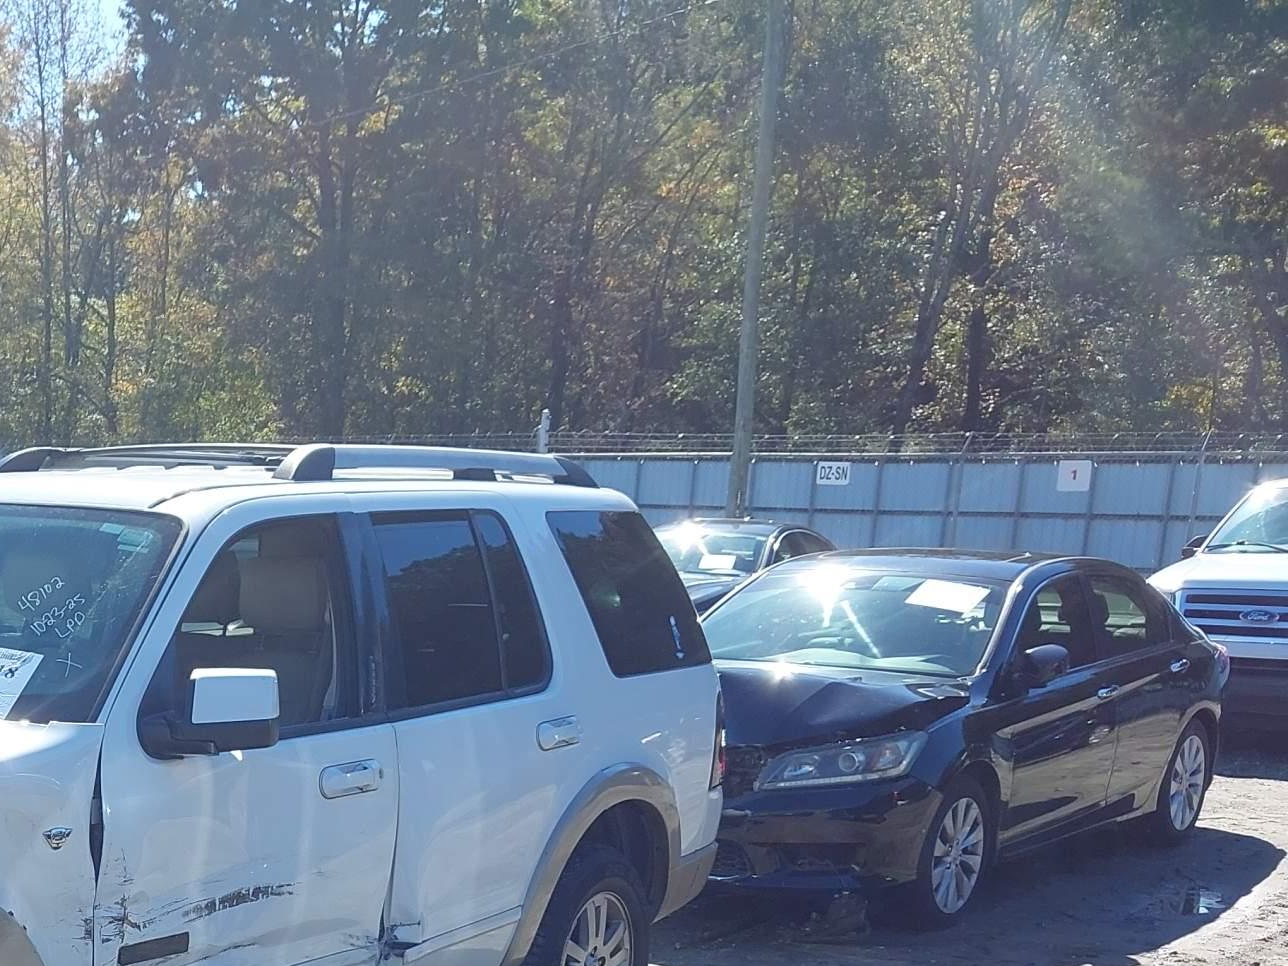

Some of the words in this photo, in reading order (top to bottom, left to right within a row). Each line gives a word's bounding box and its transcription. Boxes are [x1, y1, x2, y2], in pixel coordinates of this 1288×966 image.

[819, 465, 849, 481] DZ-SN
[1071, 469, 1077, 481] 1
[17, 576, 65, 611] 48102
